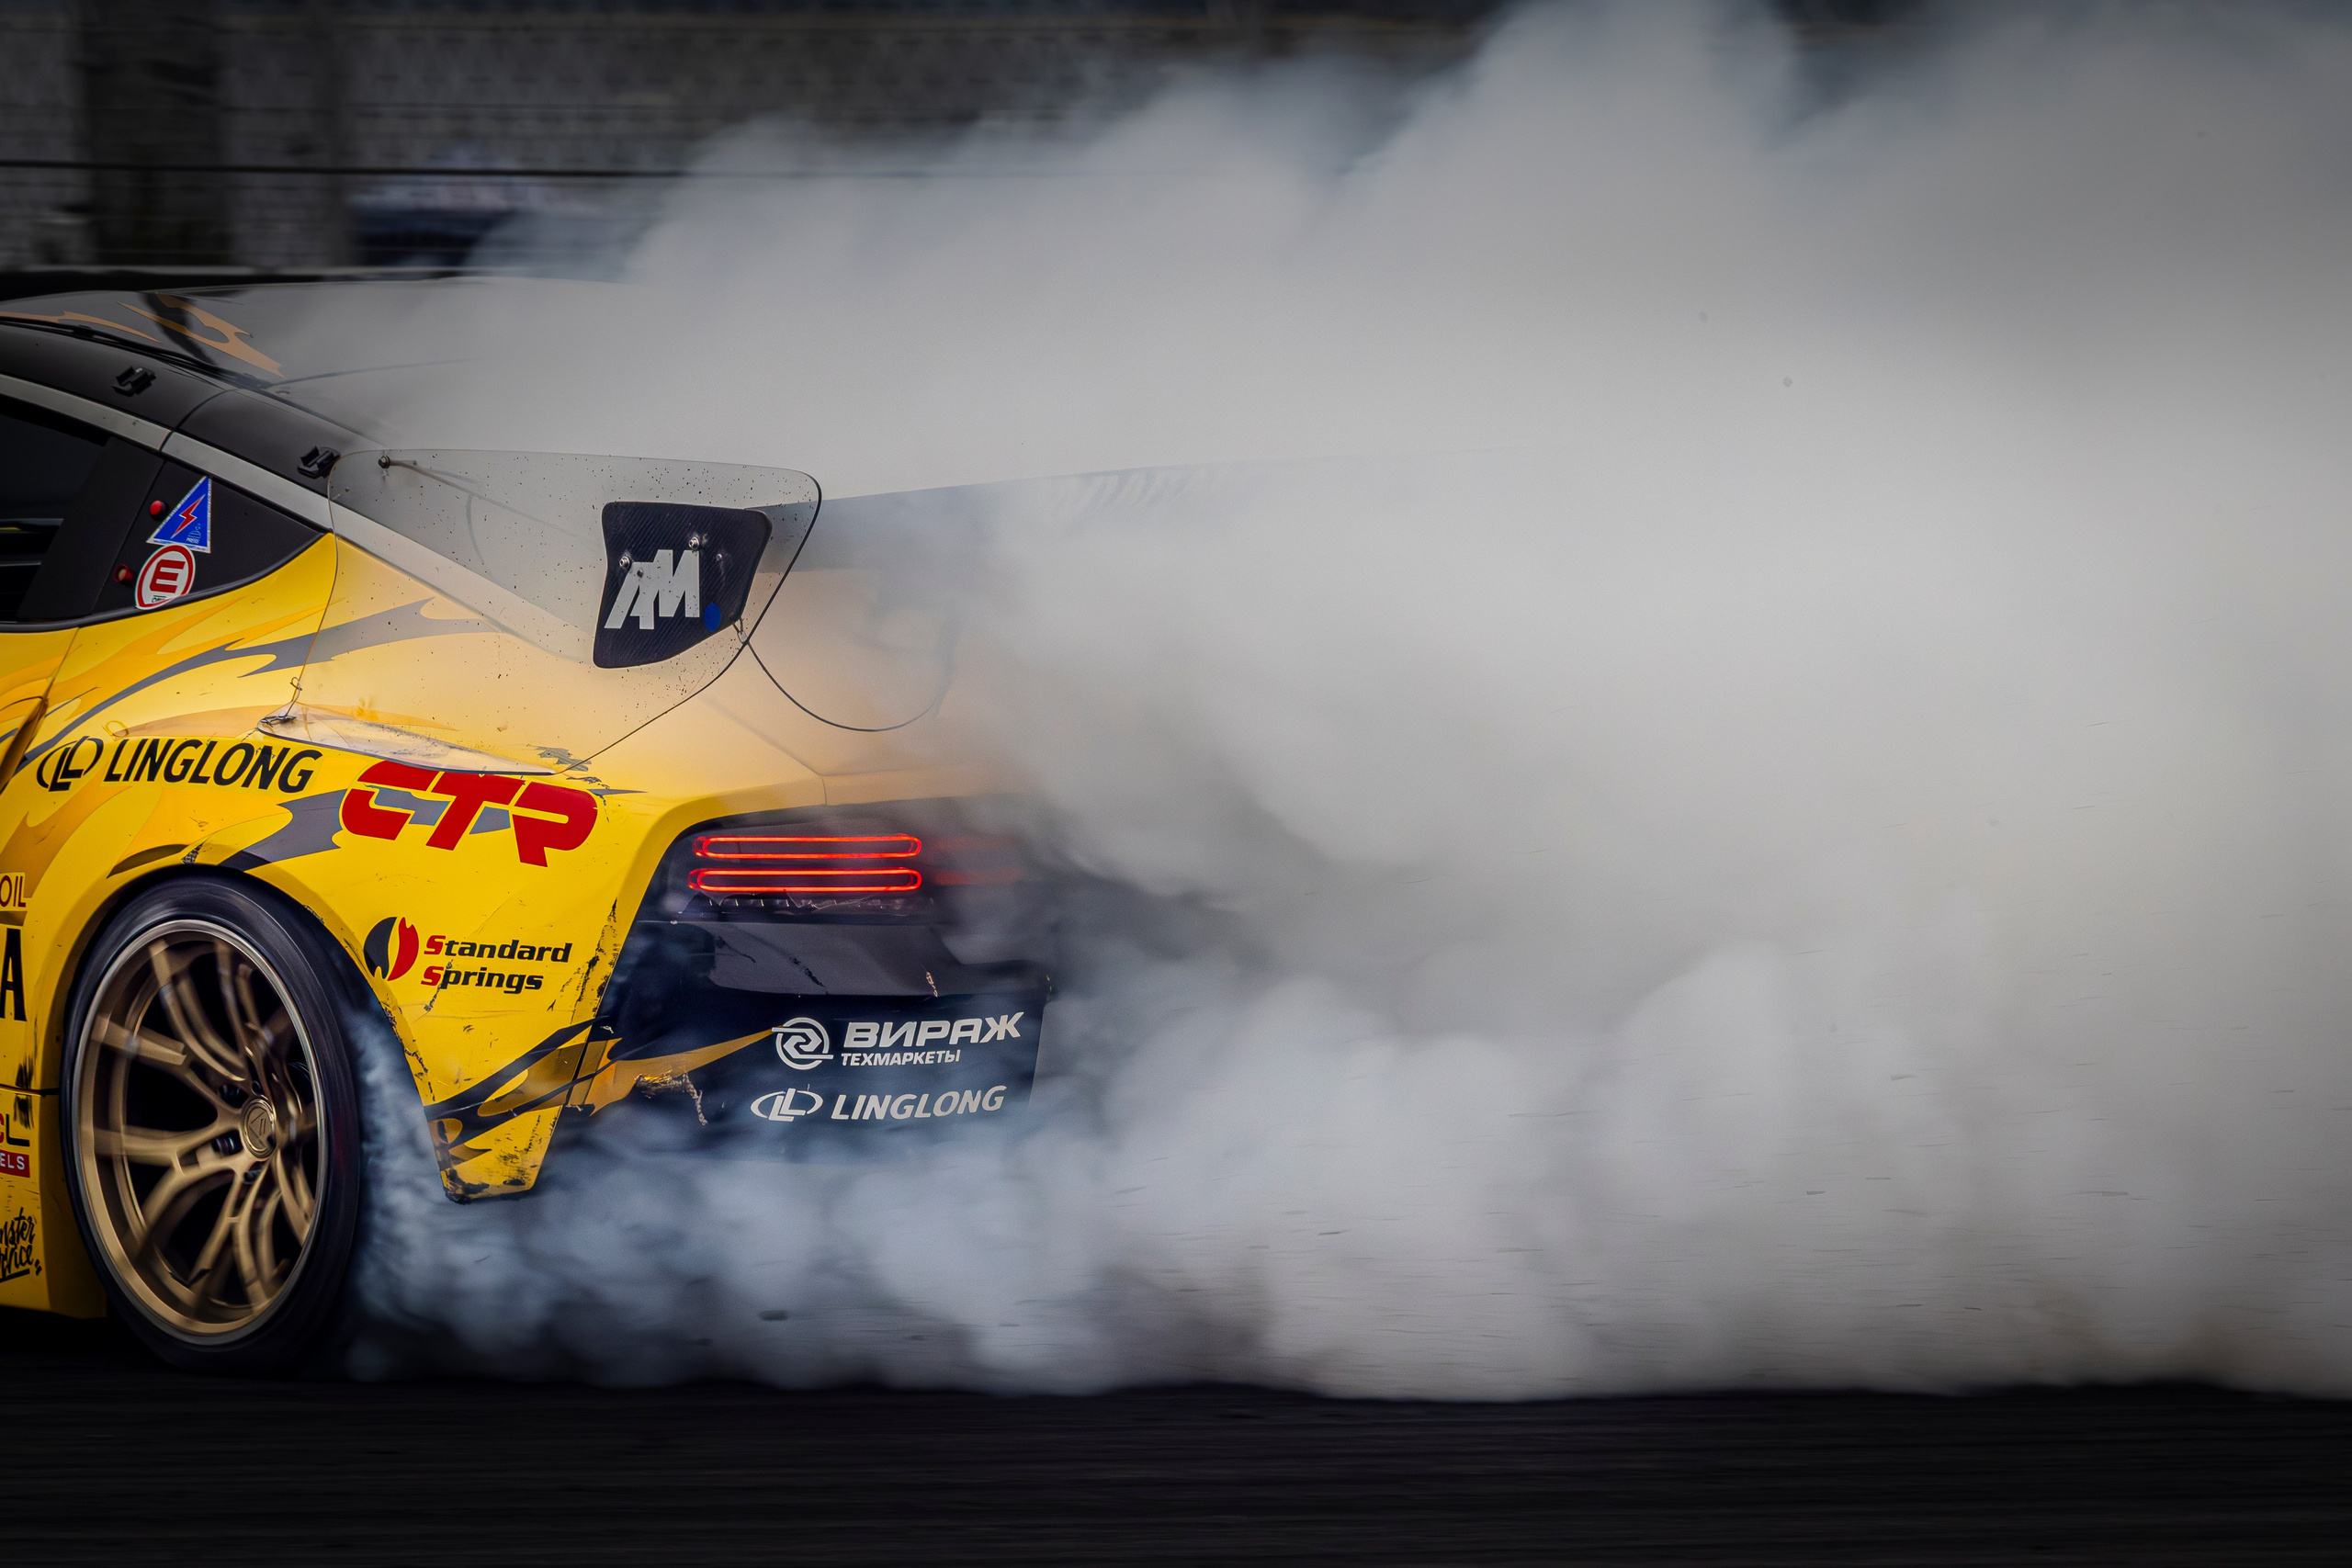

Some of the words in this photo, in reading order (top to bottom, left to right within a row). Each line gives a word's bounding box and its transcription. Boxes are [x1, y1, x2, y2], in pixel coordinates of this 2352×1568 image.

[150, 559, 186, 593] E
[104, 739, 323, 794] LINGLONG
[424, 934, 572, 963] Standard
[421, 966, 544, 994] Springs
[843, 1011, 1024, 1048] ВИРАЖ
[841, 1049, 961, 1066] ТЕХМАРКЕТЫ
[831, 1085, 1007, 1121] LINGLONG
